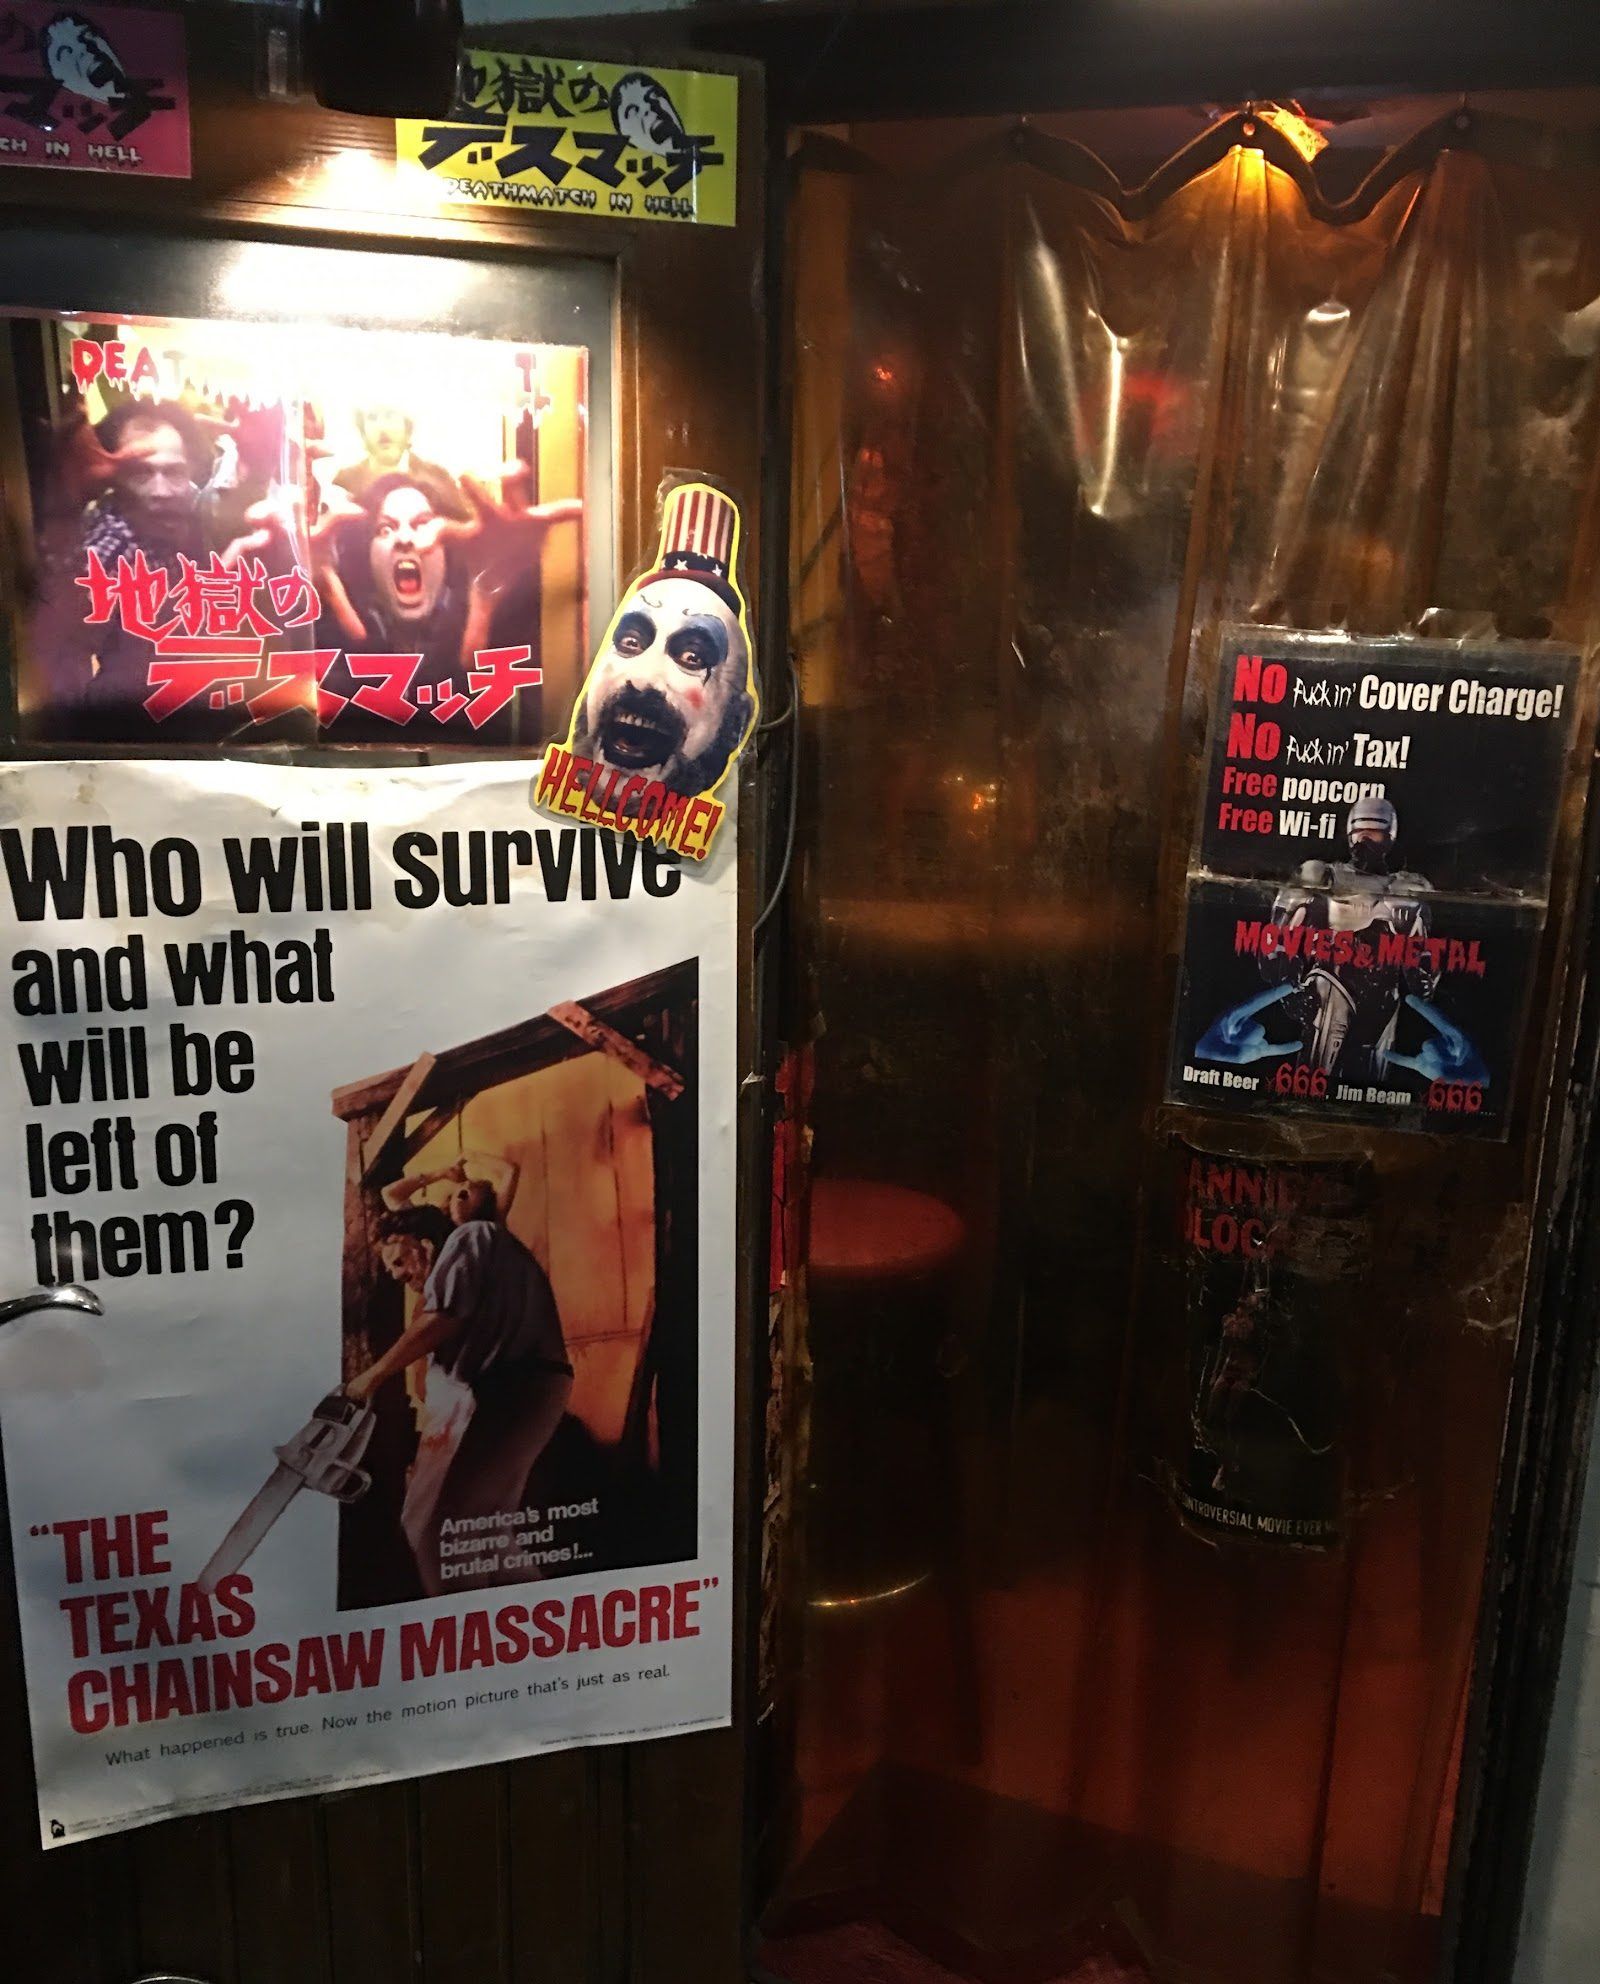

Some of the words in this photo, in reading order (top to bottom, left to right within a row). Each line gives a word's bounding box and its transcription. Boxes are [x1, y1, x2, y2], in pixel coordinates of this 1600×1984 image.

[45, 141, 70, 158] IN
[87, 143, 142, 164] HELL
[418, 106, 725, 194] デスマッチ
[443, 177, 596, 209] DEATHMATCH
[610, 192, 632, 214] IN
[645, 194, 694, 219] HELL
[75, 549, 321, 643] 地獄の
[143, 637, 543, 730] デスマッチ
[1233, 655, 1288, 703] No
[1359, 675, 1448, 713] Cover
[1448, 679, 1564, 721] Charge!
[1226, 713, 1281, 761] No
[1353, 733, 1411, 769] Tax!
[538, 747, 723, 859] HELLCOME!
[1219, 803, 1273, 834] Free
[1279, 810, 1336, 839] Wi-fi
[1222, 766, 1277, 797] Free
[1282, 777, 1385, 804] popcorn
[2, 824, 203, 922] Who
[224, 822, 371, 914] will
[392, 828, 681, 910] survive
[12, 934, 147, 1016] and
[165, 928, 335, 1005] what
[19, 1026, 149, 1107] will
[171, 1024, 254, 1096] be
[1183, 1065, 1219, 1086] Draft
[1222, 1071, 1259, 1091] Beer
[1336, 1084, 1362, 1103] Jim
[1365, 1085, 1412, 1105] Beam
[26, 1117, 138, 1198] left
[155, 1111, 217, 1187] of
[31, 1199, 254, 1286] them?
[440, 1506, 540, 1536] America's
[547, 1498, 599, 1521] most
[440, 1533, 509, 1558] bizarre
[515, 1525, 554, 1546] and
[1256, 1516, 1293, 1537] MOVIE
[1296, 1520, 1323, 1537] EVER
[440, 1554, 499, 1580] brutal
[59, 1573, 256, 1659] TEXAS
[67, 1628, 385, 1735] CHAINSAW
[105, 1748, 151, 1766] What
[160, 1730, 245, 1757] happened
[254, 1729, 268, 1743] is
[322, 1715, 358, 1731] Now
[366, 1709, 392, 1724] the
[401, 1697, 457, 1718] motion
[465, 1687, 519, 1709] picture
[528, 1676, 569, 1697] that's
[575, 1672, 604, 1691] just
[612, 1671, 631, 1684] as
[638, 1664, 670, 1680] real.
